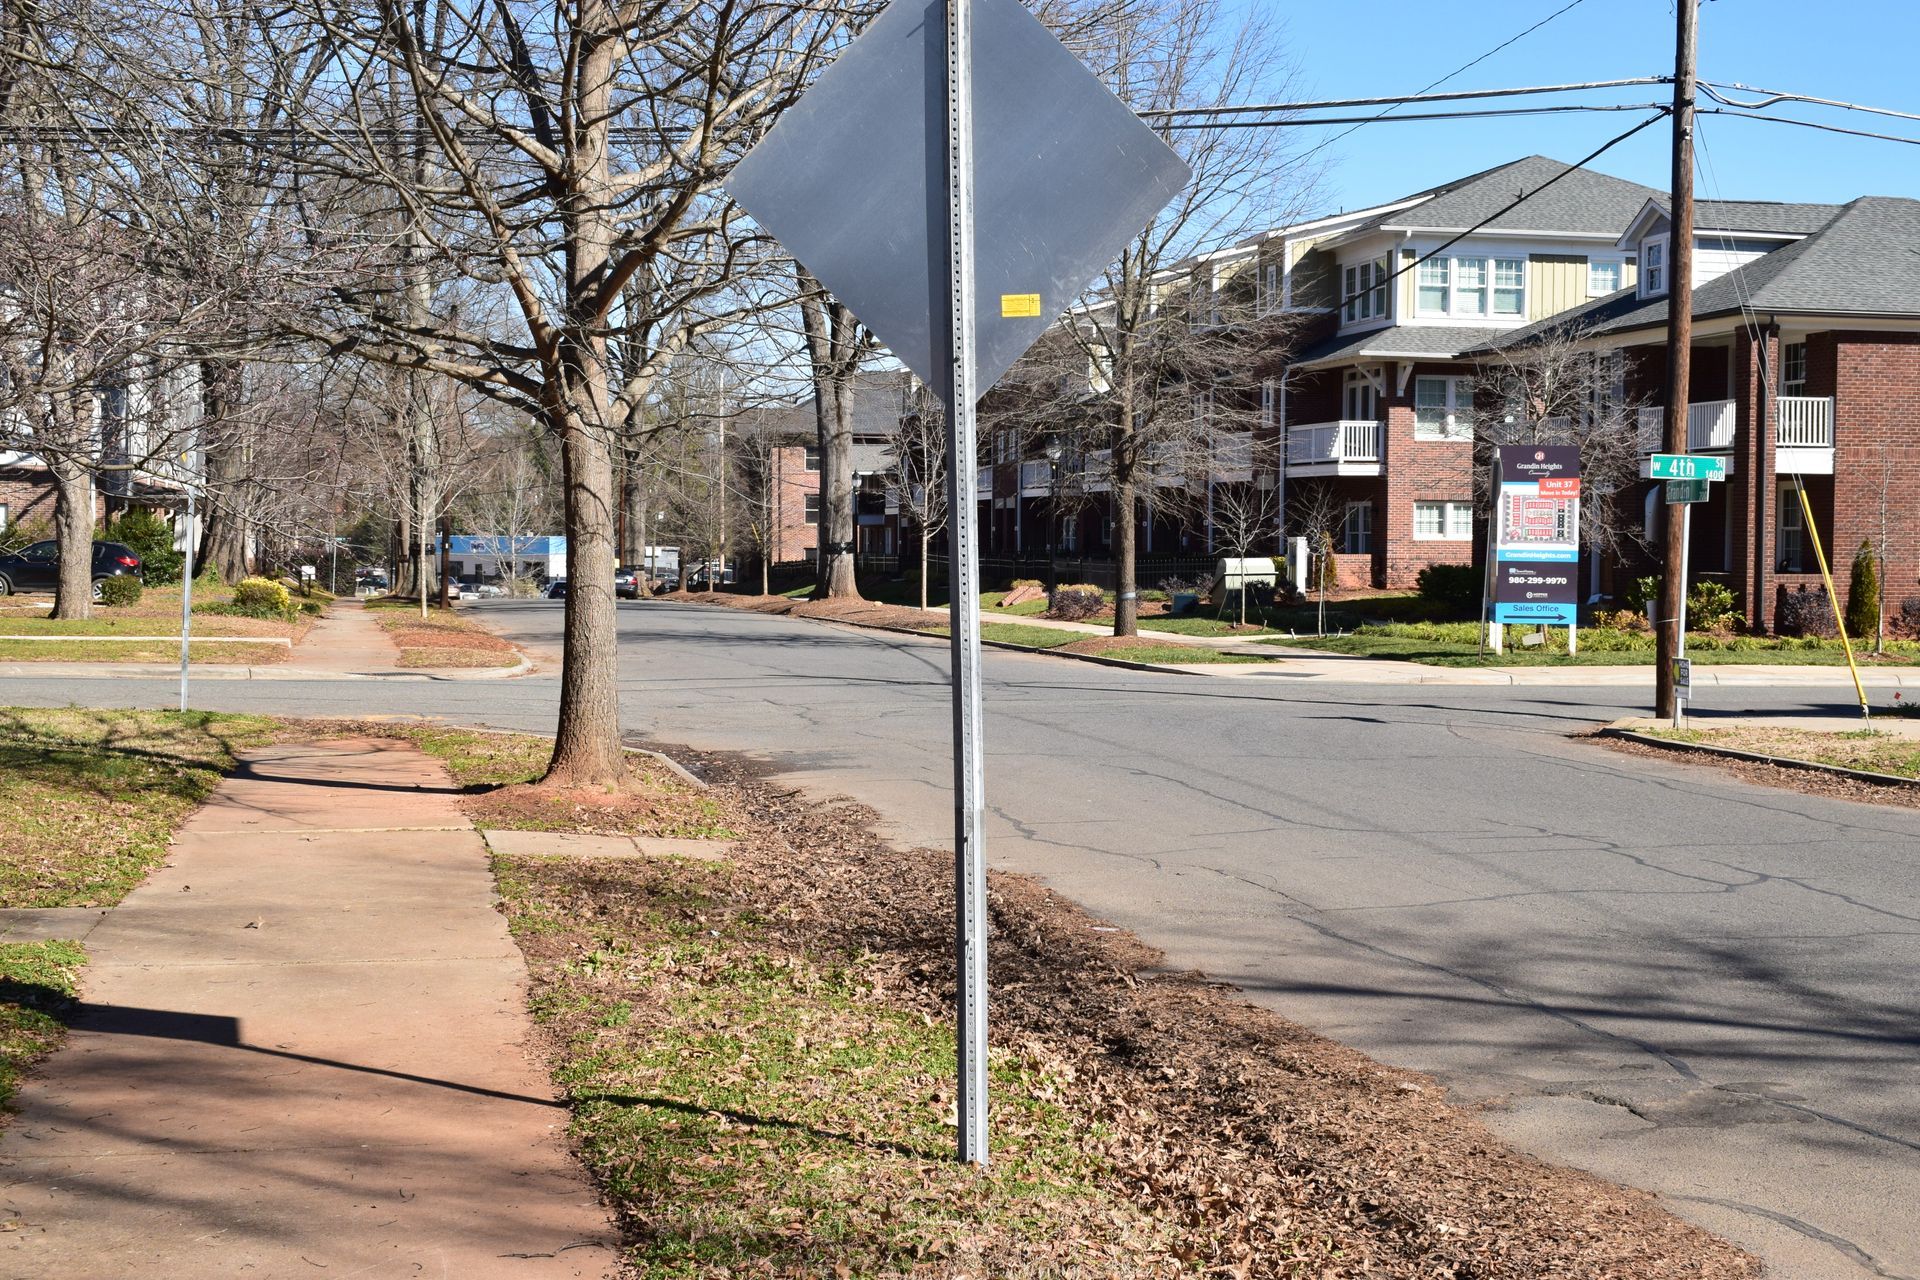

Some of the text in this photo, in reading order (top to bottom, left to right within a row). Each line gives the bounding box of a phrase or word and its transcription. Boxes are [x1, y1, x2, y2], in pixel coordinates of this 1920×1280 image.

[1653, 458, 1695, 477] W 4th
[1716, 458, 1723, 468] St
[1705, 470, 1723, 480] 1400
[1680, 669, 1688, 677] FOR
[1680, 677, 1689, 685] SALE
